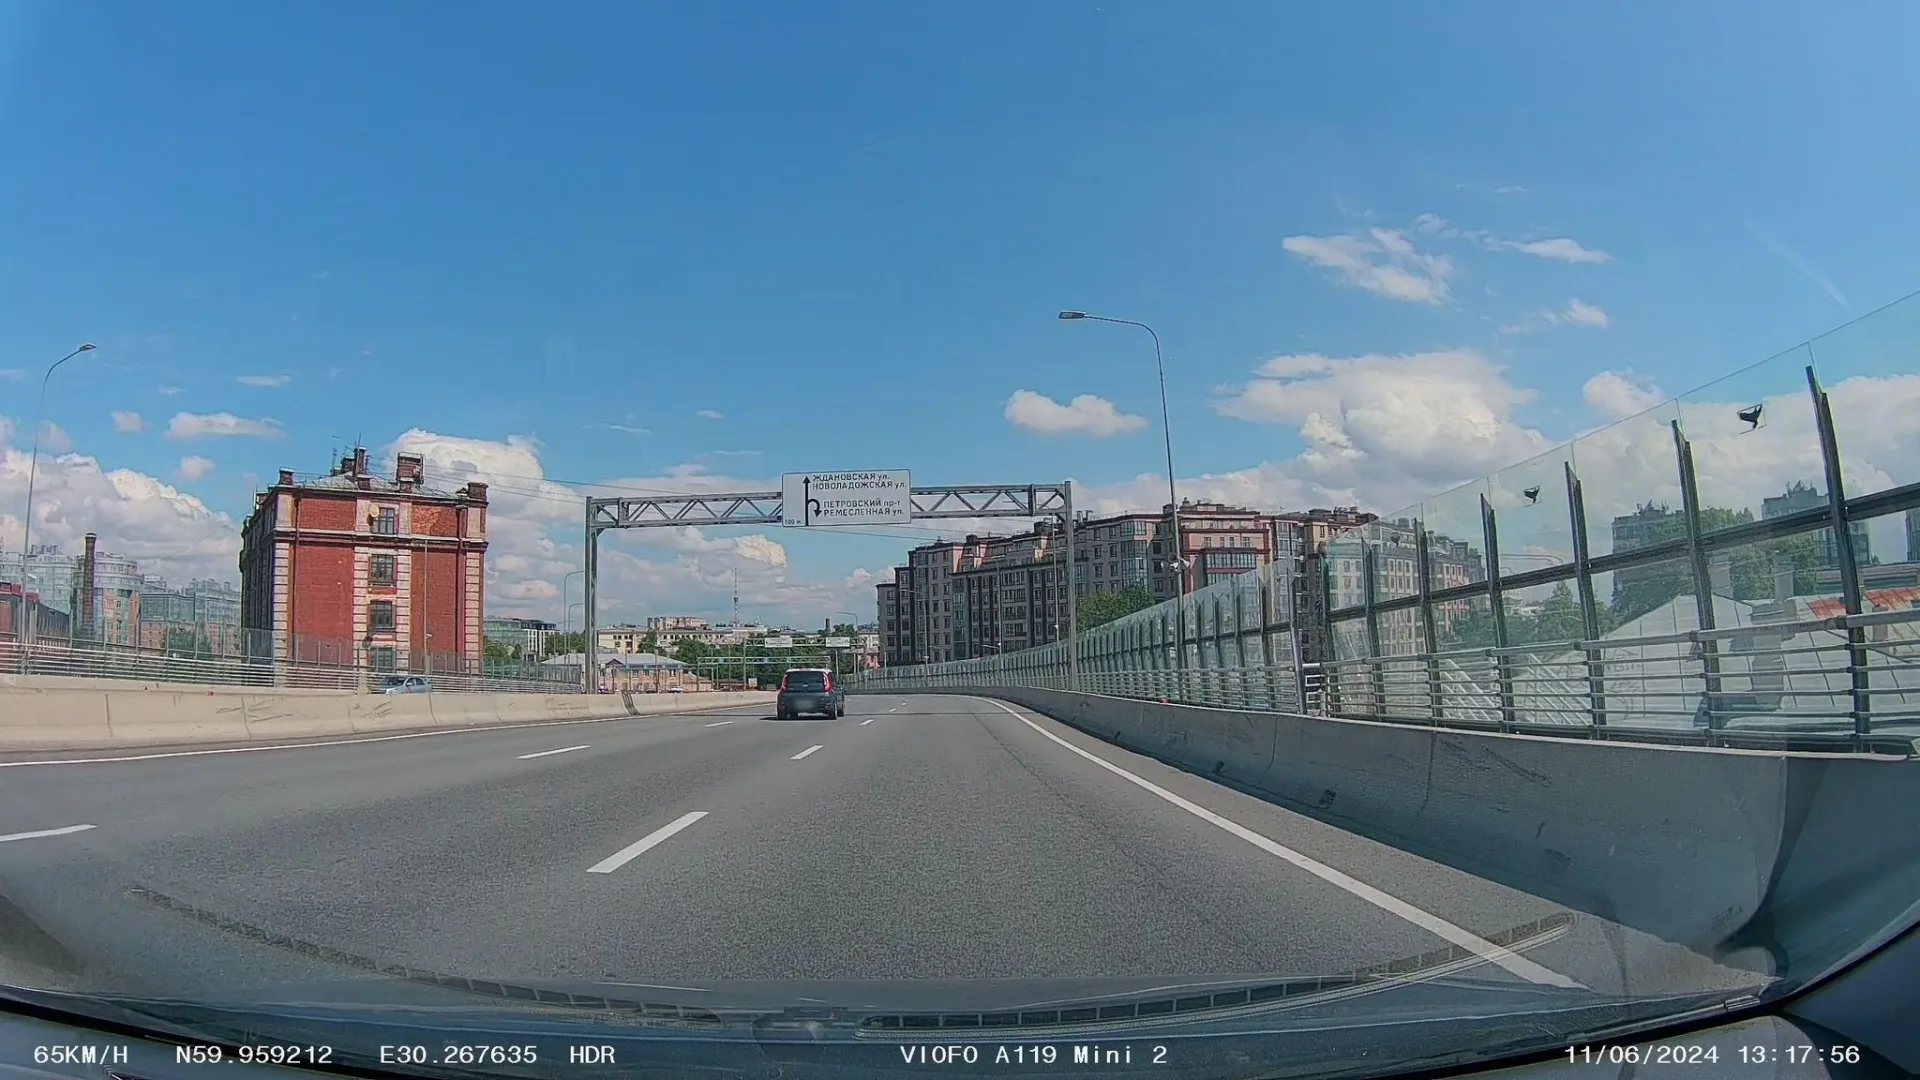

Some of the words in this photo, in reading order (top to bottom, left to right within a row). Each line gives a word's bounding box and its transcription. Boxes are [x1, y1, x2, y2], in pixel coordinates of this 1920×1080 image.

[813, 473, 876, 482] ЖДАНОВСКАЯ
[877, 473, 890, 481] ул.
[812, 481, 892, 490] НОВОЛАДОЖСКАЯ
[894, 482, 907, 490] ул.
[823, 498, 881, 508] ПЕТРОВСКИЙ
[883, 500, 901, 508] пр-т
[824, 507, 890, 517] РЕМЕСЛЕННАЯ
